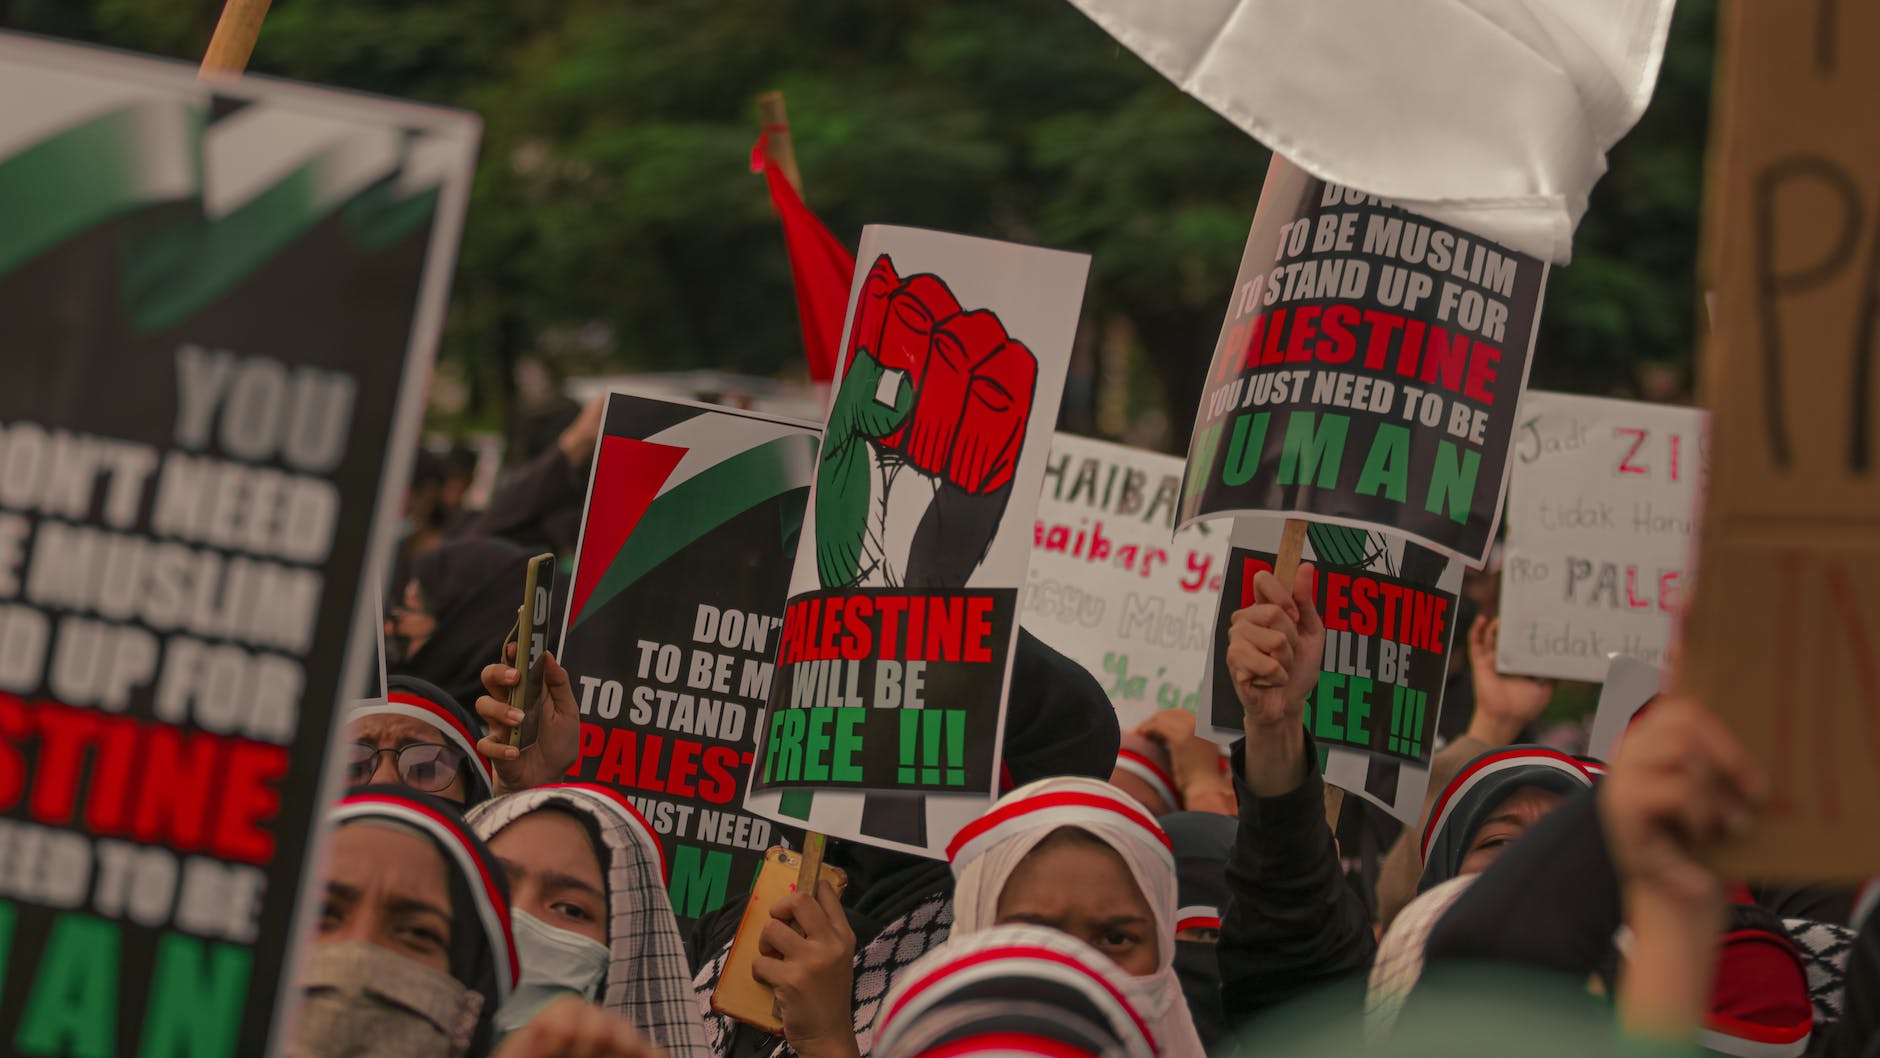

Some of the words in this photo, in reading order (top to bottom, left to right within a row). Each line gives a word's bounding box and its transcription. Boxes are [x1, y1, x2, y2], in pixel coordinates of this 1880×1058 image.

[1275, 217, 1311, 262] TO
[1312, 212, 1359, 253] BE
[1362, 214, 1517, 298] MUSLIM
[1236, 274, 1264, 320] TO
[1264, 259, 1369, 306] STAND
[1376, 264, 1433, 312] UP
[1436, 281, 1509, 343] FOR
[1216, 304, 1501, 405] PALESTINE
[174, 345, 357, 472] YOU
[1206, 379, 1245, 422] YOU
[1242, 370, 1310, 408] JUST
[1311, 370, 1394, 414] NEED
[1402, 385, 1443, 427] TO
[1447, 402, 1489, 445] BE
[150, 451, 340, 563] NEED
[25, 521, 323, 654] MUSLIM
[637, 640, 681, 684] TO
[687, 650, 737, 693] BE
[777, 595, 994, 667] PALESTINE
[1378, 639, 1412, 688] BE
[51, 616, 160, 713] UP
[153, 632, 306, 745] FOR
[580, 676, 623, 720] TO
[629, 686, 746, 742] STAND
[790, 659, 864, 709] WILL
[873, 659, 927, 710] BE
[763, 707, 866, 784] FREE
[897, 709, 967, 786] !!!
[1388, 685, 1427, 758] !!!
[696, 809, 772, 852] NEED
[94, 838, 179, 927] TO
[176, 853, 267, 944] BE
